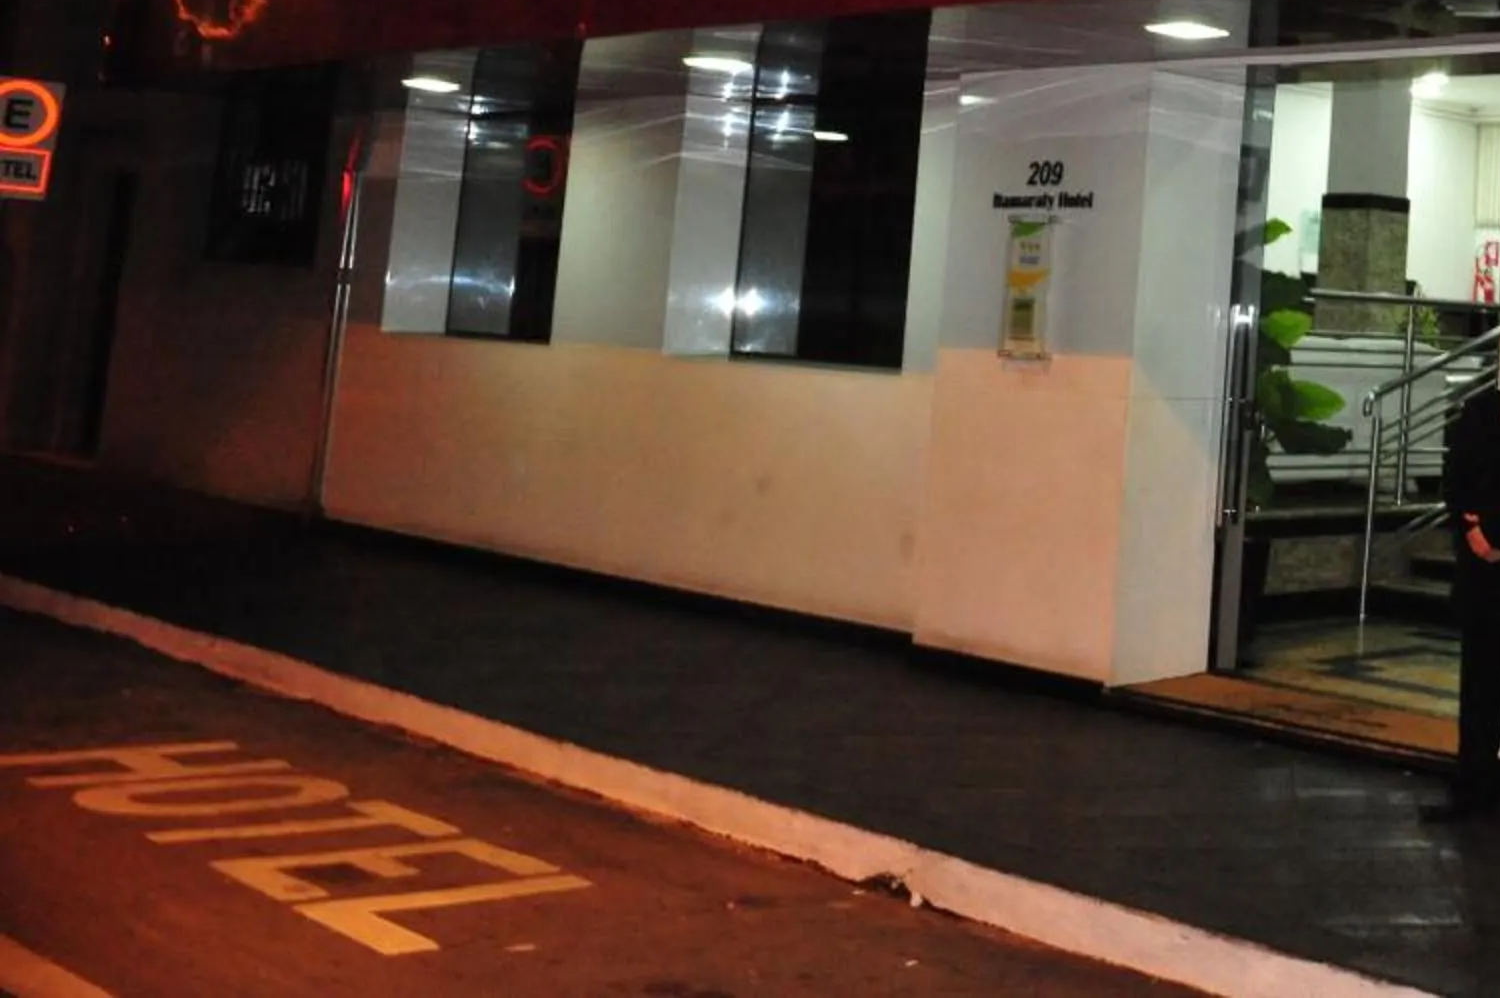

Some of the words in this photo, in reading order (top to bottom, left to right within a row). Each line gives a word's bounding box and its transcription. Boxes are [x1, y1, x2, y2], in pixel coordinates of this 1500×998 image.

[4, 98, 34, 129] E
[1026, 161, 1064, 186] 209
[0, 740, 593, 956] HOTEL
